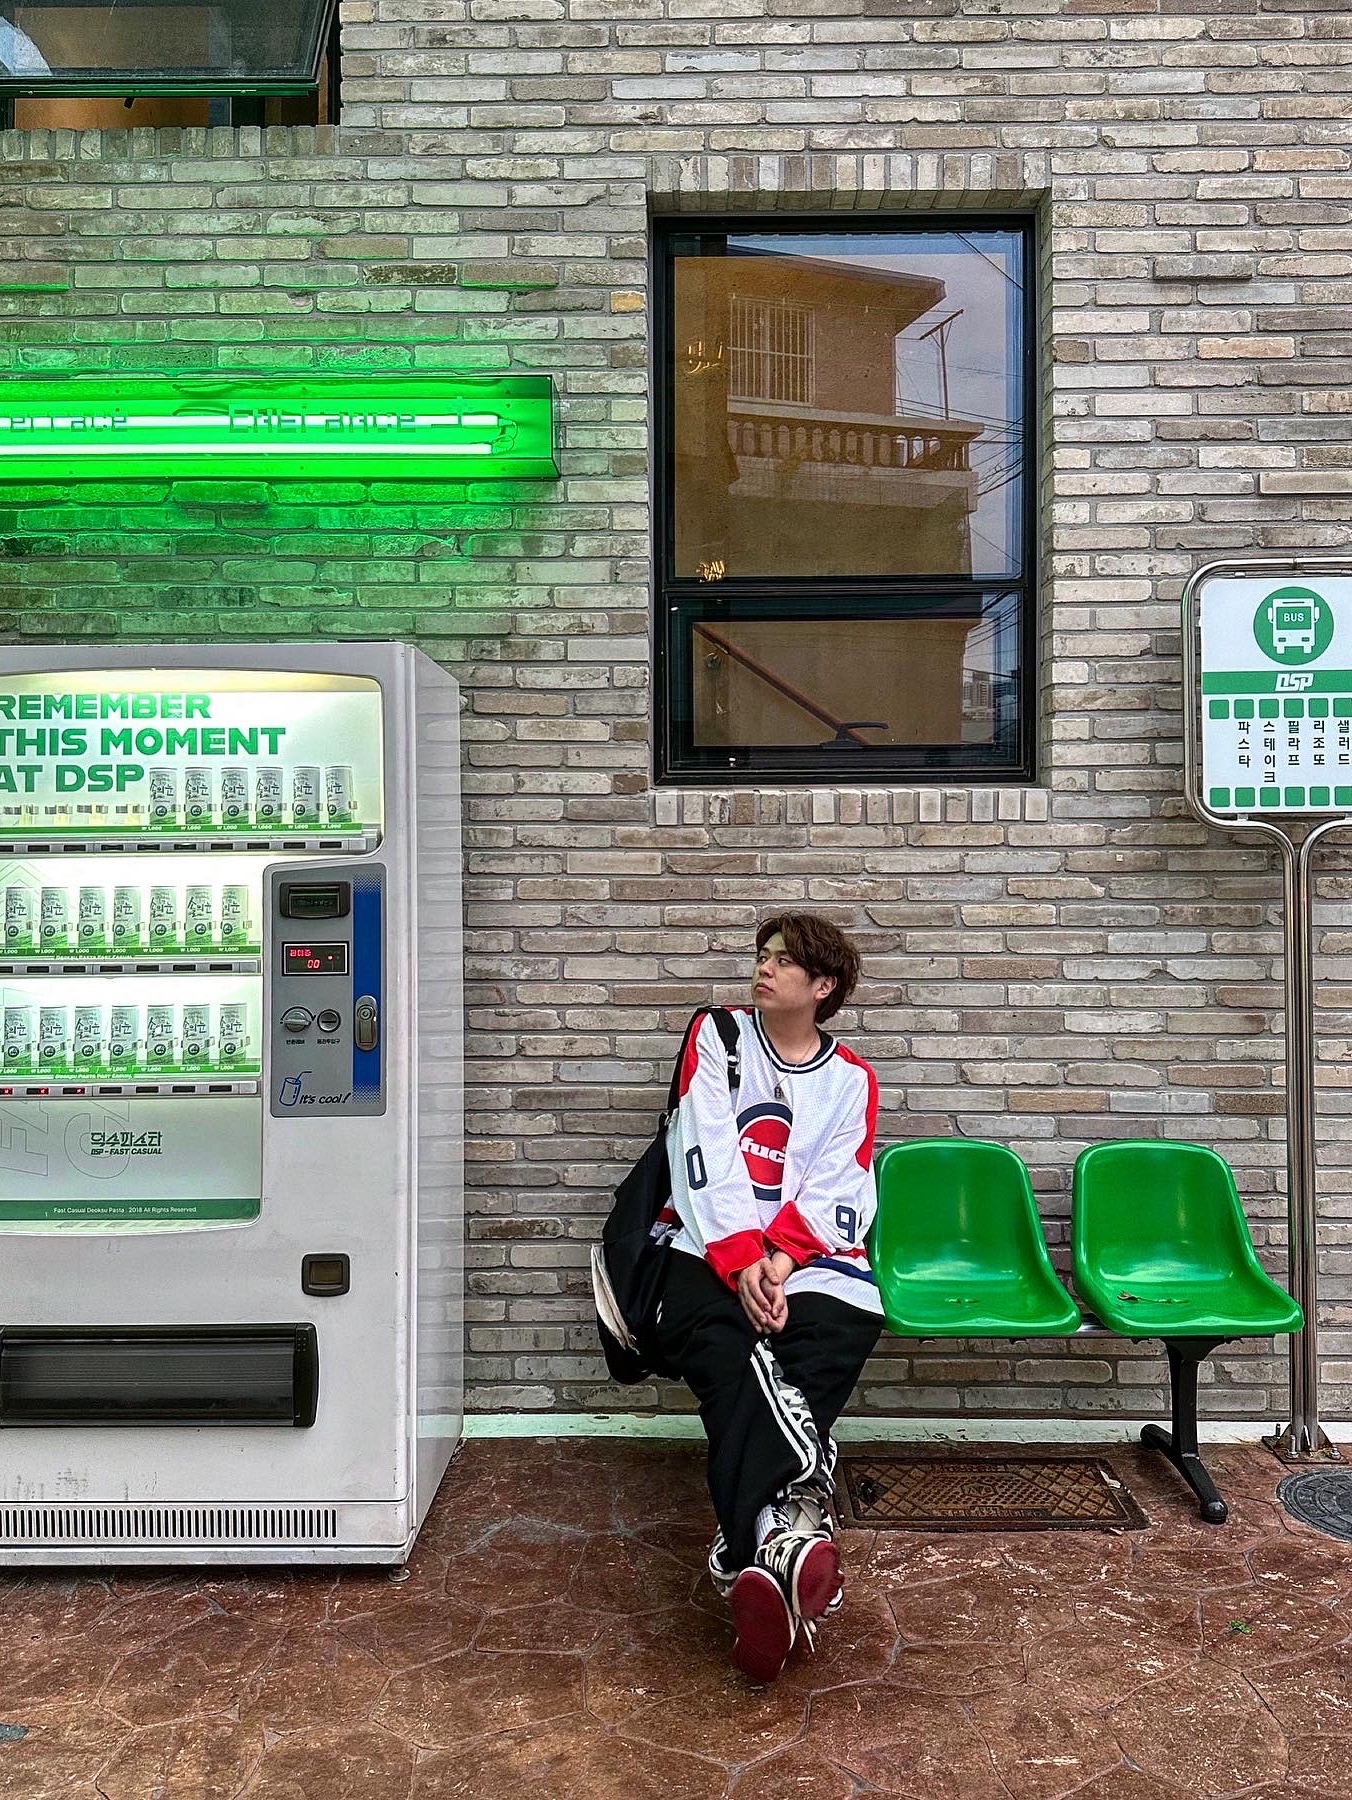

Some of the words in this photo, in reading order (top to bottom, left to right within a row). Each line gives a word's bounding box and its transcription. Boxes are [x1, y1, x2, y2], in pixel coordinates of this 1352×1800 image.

[1284, 613, 1304, 622] BUS
[1275, 673, 1314, 692] DSP
[0, 694, 212, 720] REMEMBER
[0, 728, 87, 756] THIS
[101, 727, 286, 755] MOMENT
[1238, 721, 1251, 768] 파스타
[1263, 721, 1276, 783] 스테이크
[1288, 720, 1300, 766] 필라프
[1313, 720, 1325, 766] 리조또
[1337, 719, 1350, 765] 샐러드
[0, 764, 43, 792] AT
[56, 764, 144, 792] DSP
[740, 1136, 786, 1164] fuc
[836, 1205, 862, 1244] 9
